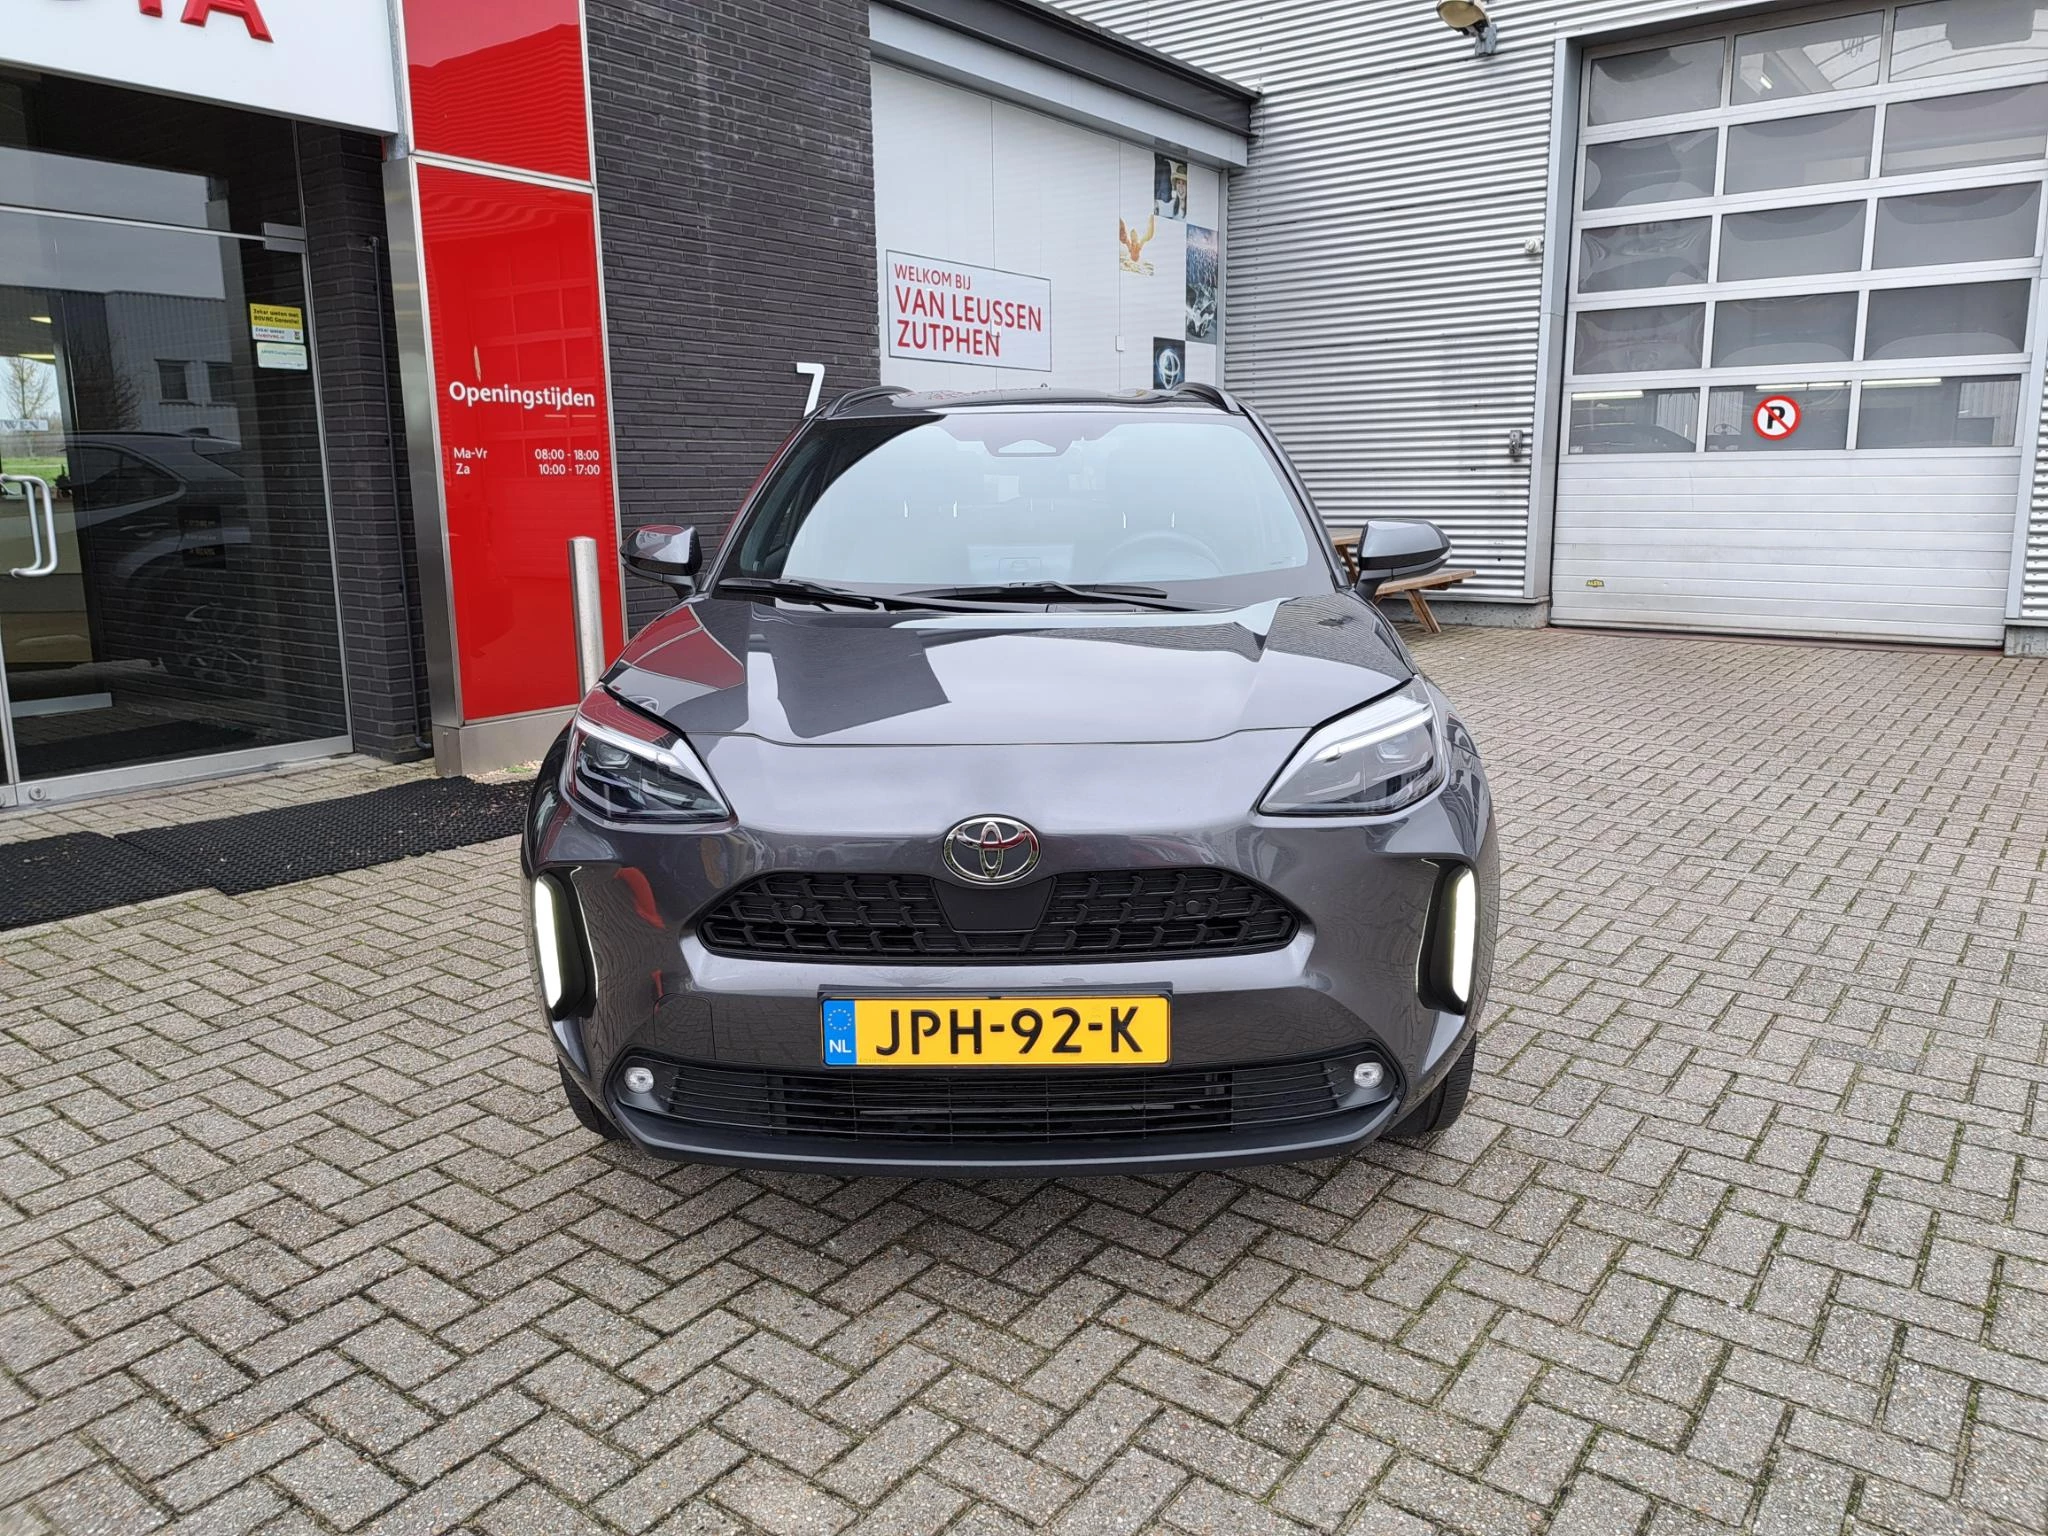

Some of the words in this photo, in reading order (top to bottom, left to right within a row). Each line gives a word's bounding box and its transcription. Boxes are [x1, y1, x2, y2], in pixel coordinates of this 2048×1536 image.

[894, 263, 952, 287] WELKOM
[956, 273, 971, 291] BIJ
[895, 285, 945, 319] VAN
[952, 294, 1042, 332] LEUSSEN
[897, 319, 1000, 357] ZUTPHEN
[449, 381, 596, 411] Openingstijden
[796, 362, 826, 417] 7
[453, 447, 488, 459] Ma-Vr
[534, 448, 565, 461] 08:00
[574, 449, 600, 461] 18:00
[455, 463, 471, 475] Za
[539, 464, 566, 475] 10:00
[575, 464, 600, 475] 17:00
[829, 1039, 852, 1054] NL
[876, 1006, 1143, 1056] JPH-92-K
